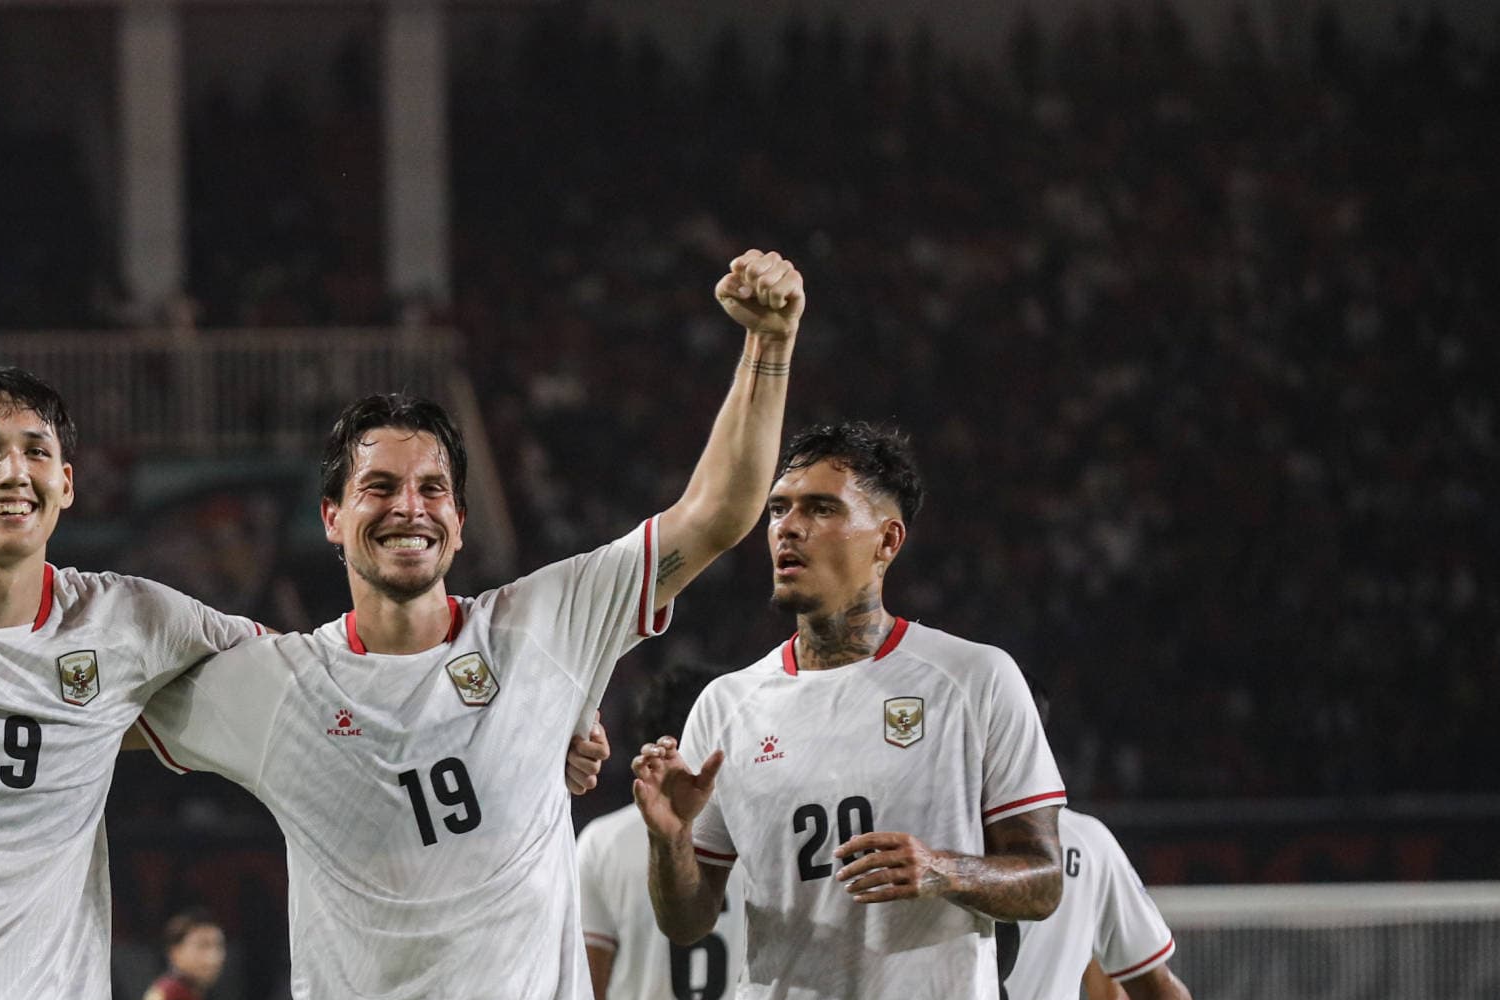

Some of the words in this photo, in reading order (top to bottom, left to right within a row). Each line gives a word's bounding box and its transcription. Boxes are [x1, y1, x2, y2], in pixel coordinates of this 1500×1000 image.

[0, 715, 41, 789] 9
[754, 751, 785, 763] KELME
[398, 757, 482, 847] 19
[793, 796, 875, 881] 20
